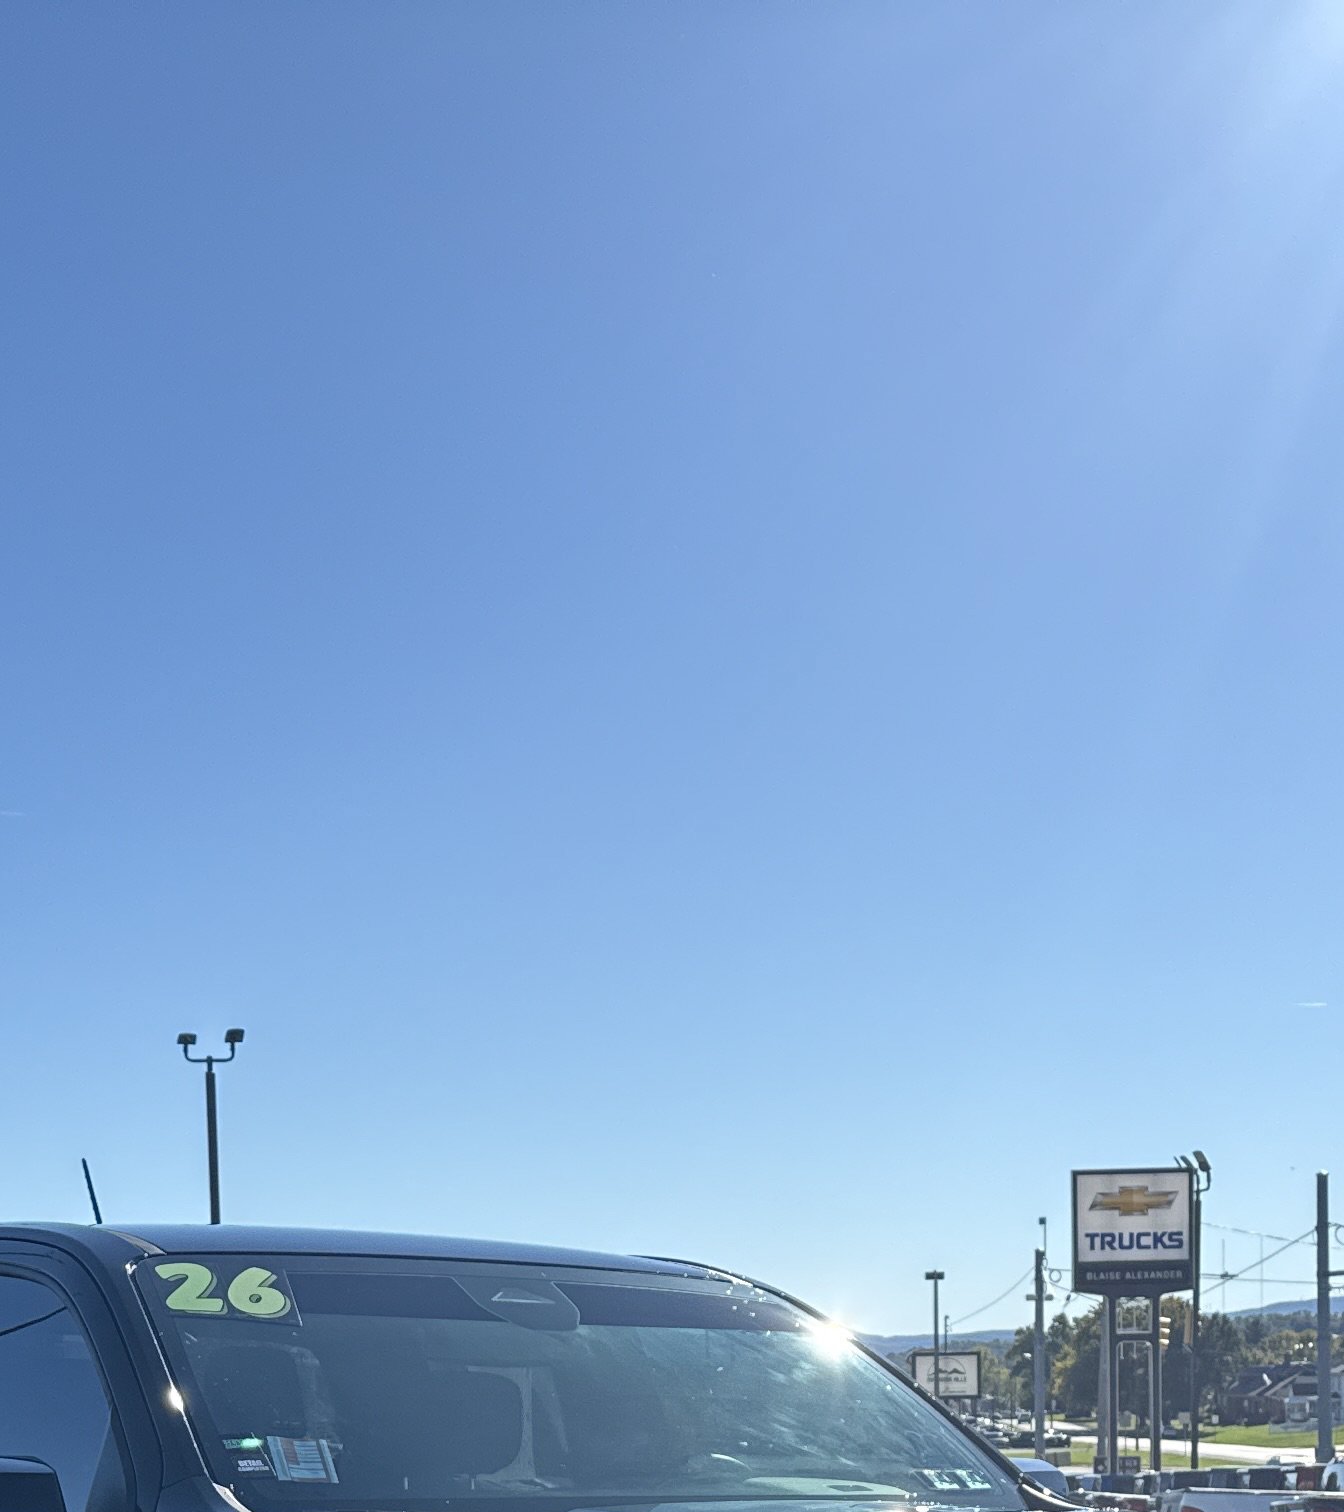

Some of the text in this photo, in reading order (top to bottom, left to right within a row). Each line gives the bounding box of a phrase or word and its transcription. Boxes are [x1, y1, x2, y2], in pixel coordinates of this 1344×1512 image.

[1084, 1230, 1184, 1251] TRUCKS
[1086, 1270, 1183, 1281] BLAISE ALEXANDER
[154, 1262, 291, 1319] 26
